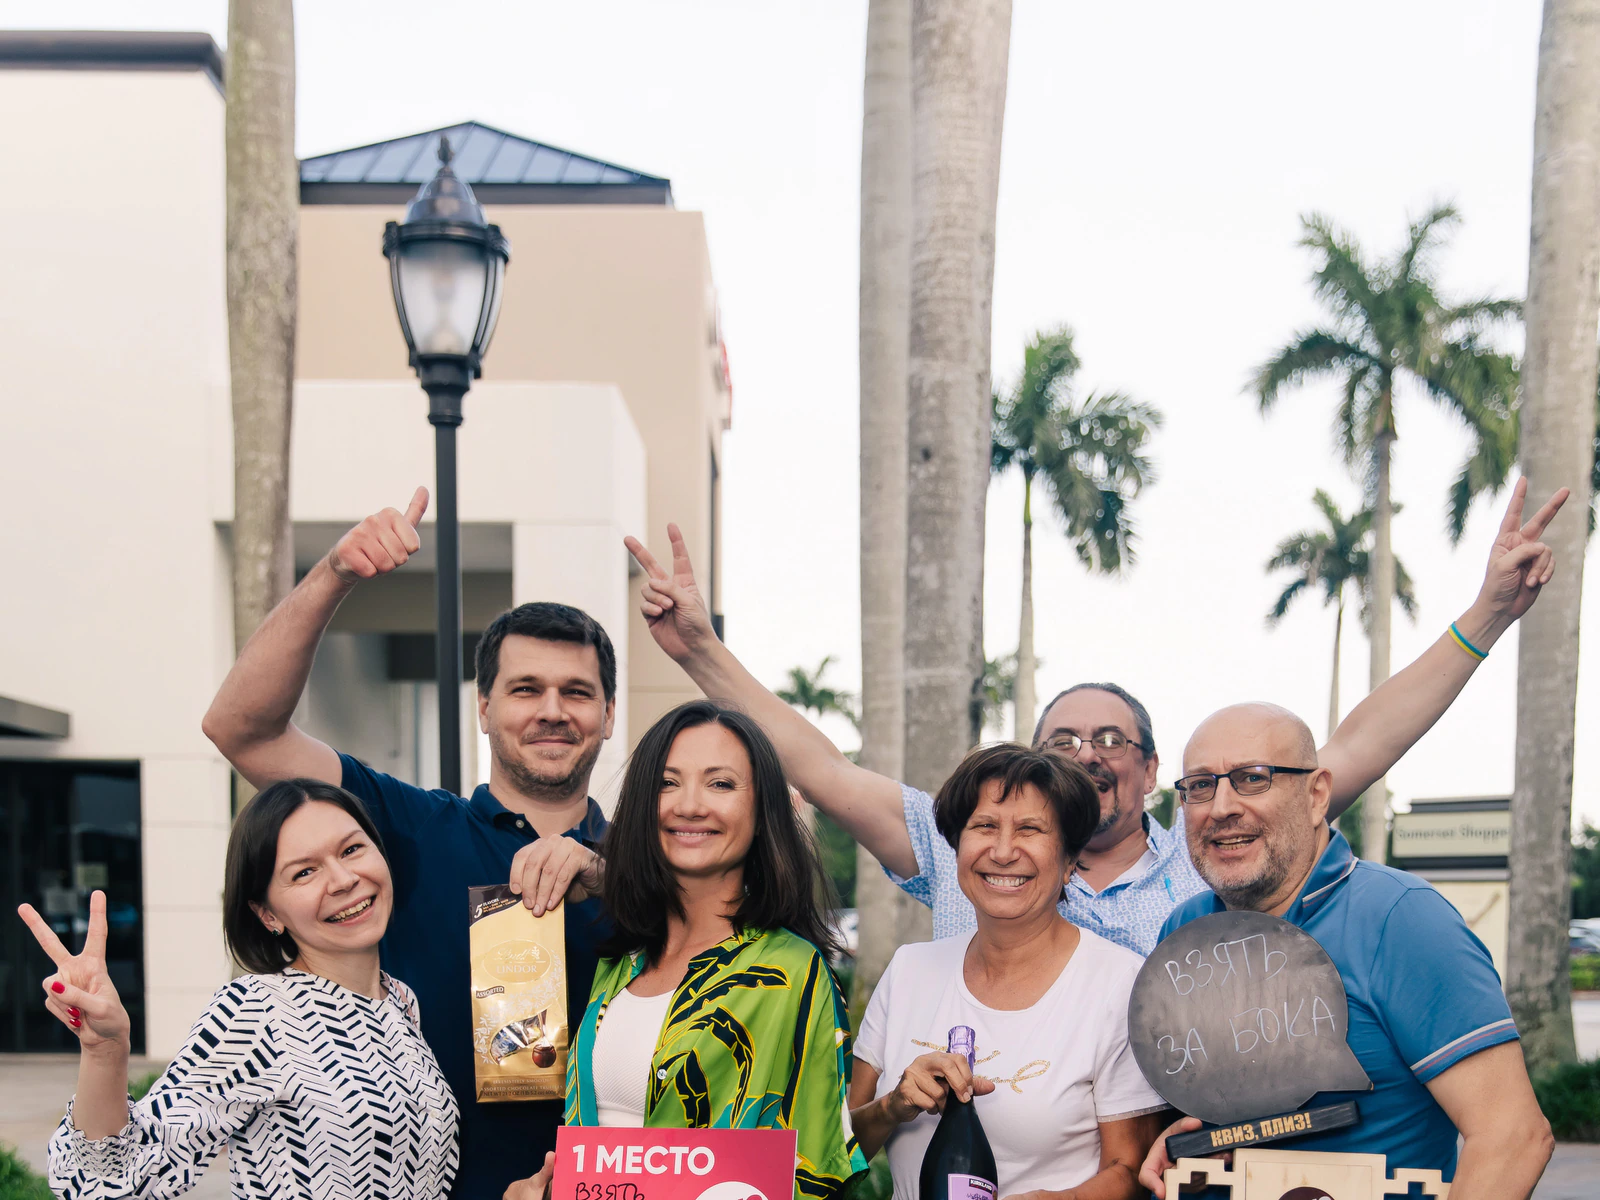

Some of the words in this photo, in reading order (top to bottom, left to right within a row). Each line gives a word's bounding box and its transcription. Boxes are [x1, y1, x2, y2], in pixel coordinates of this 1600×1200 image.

[474, 904, 482, 918] 5
[496, 964, 537, 974] LINDOR
[1164, 933, 1287, 996] ВЗЯТЬ
[476, 986, 504, 998] ASSORTED
[1157, 1028, 1208, 1075] ЗА
[1229, 995, 1335, 1054] БОКА
[1210, 1124, 1259, 1148] КВИЗ,
[1260, 1112, 1312, 1138] ПЛИЗ!
[572, 1144, 585, 1173] 1
[595, 1144, 715, 1176] МЕСТО
